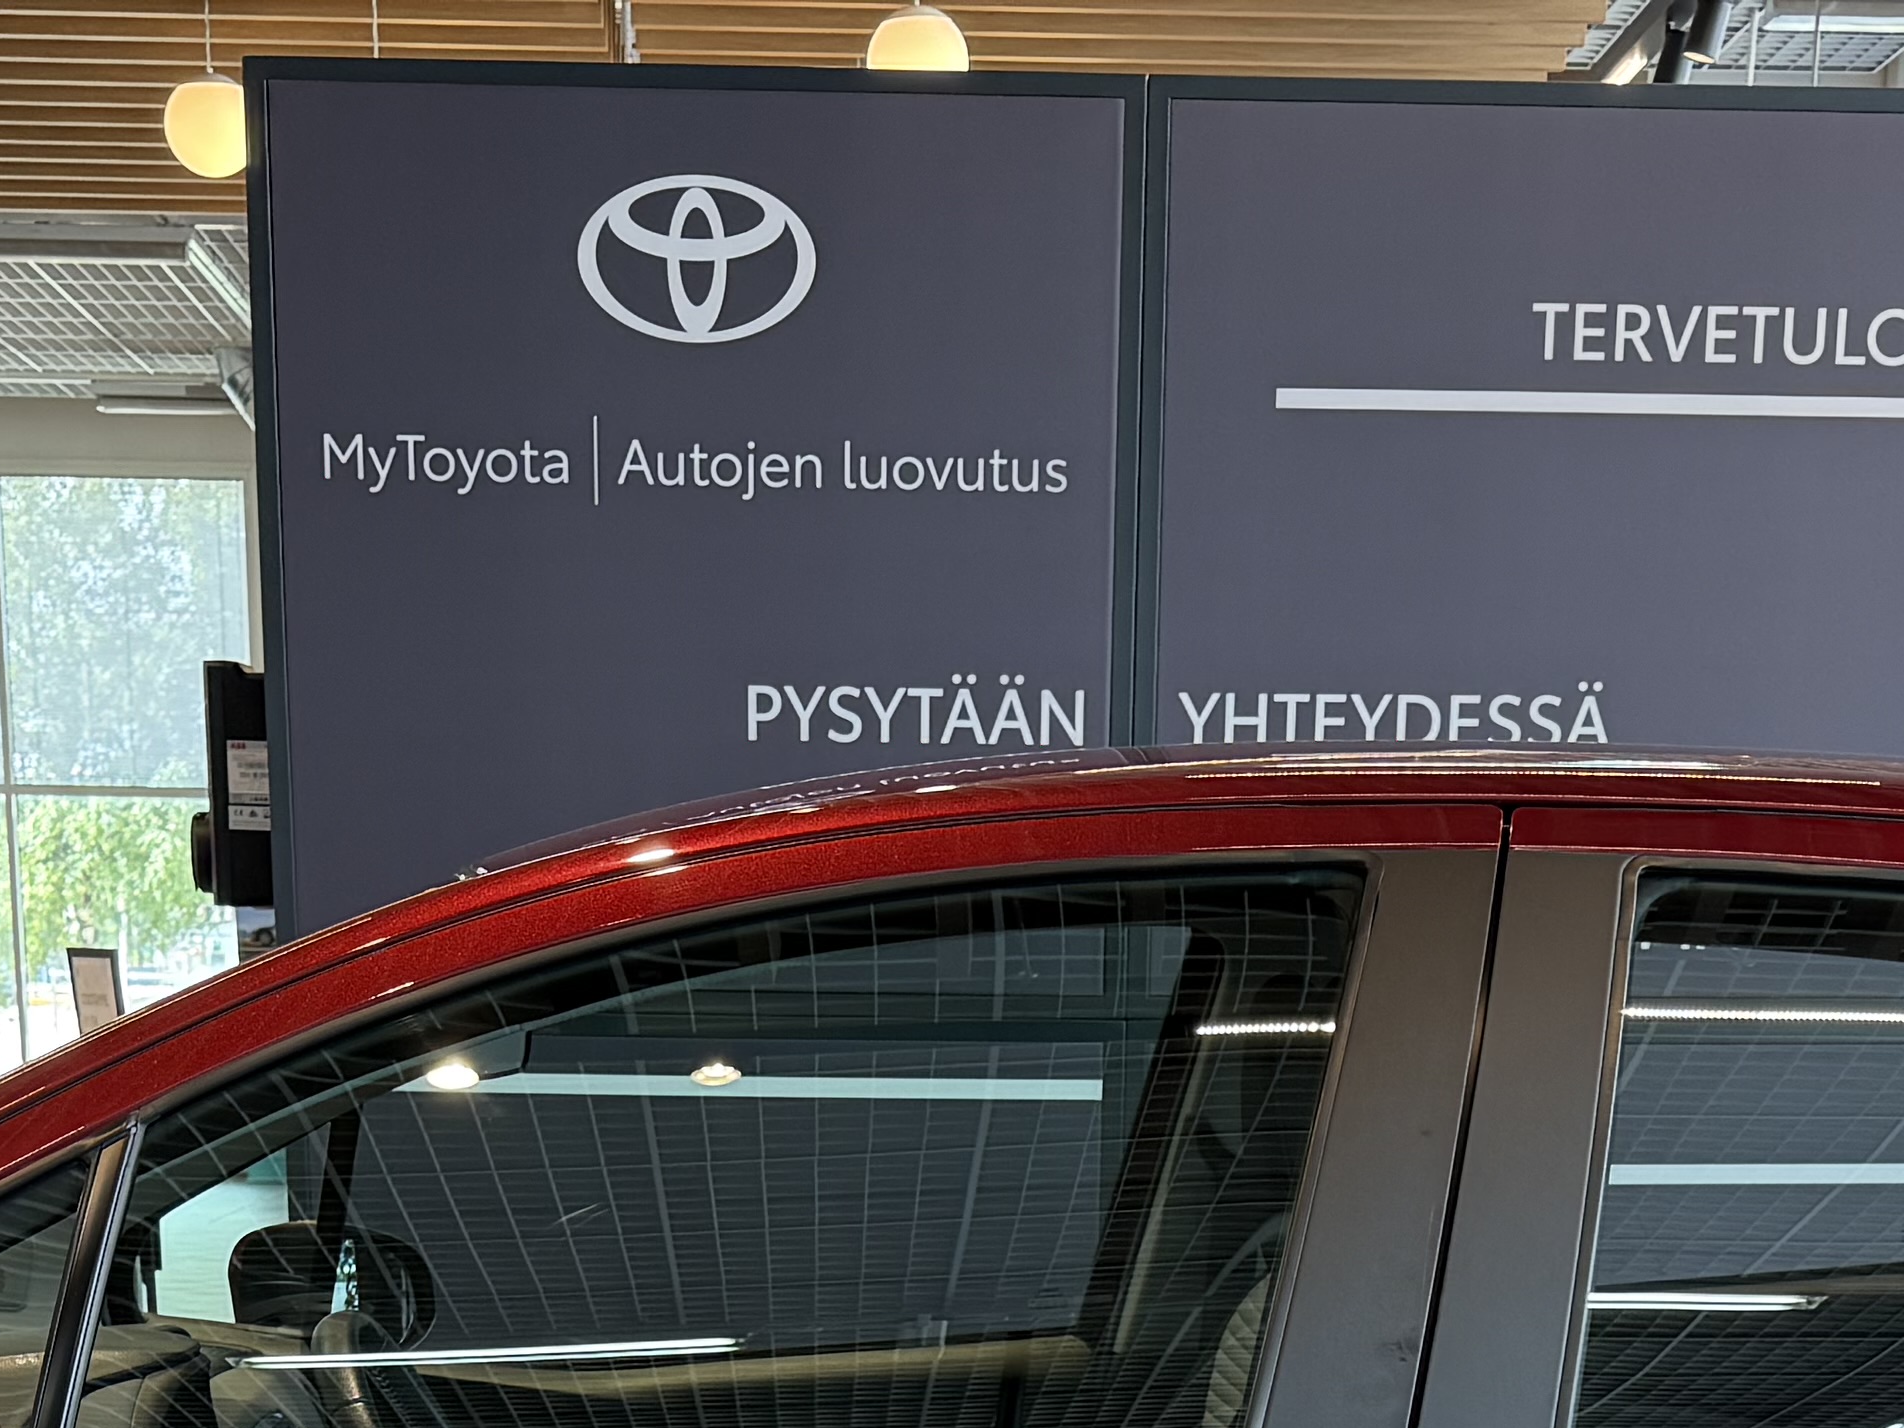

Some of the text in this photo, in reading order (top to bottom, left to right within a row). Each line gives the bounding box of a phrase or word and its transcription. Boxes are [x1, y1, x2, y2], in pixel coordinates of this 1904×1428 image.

[324, 434, 1067, 500] MyToyota Autojen luovutus
[748, 674, 1607, 746] PYSYTÄÄN YHTEYDESSÄ
